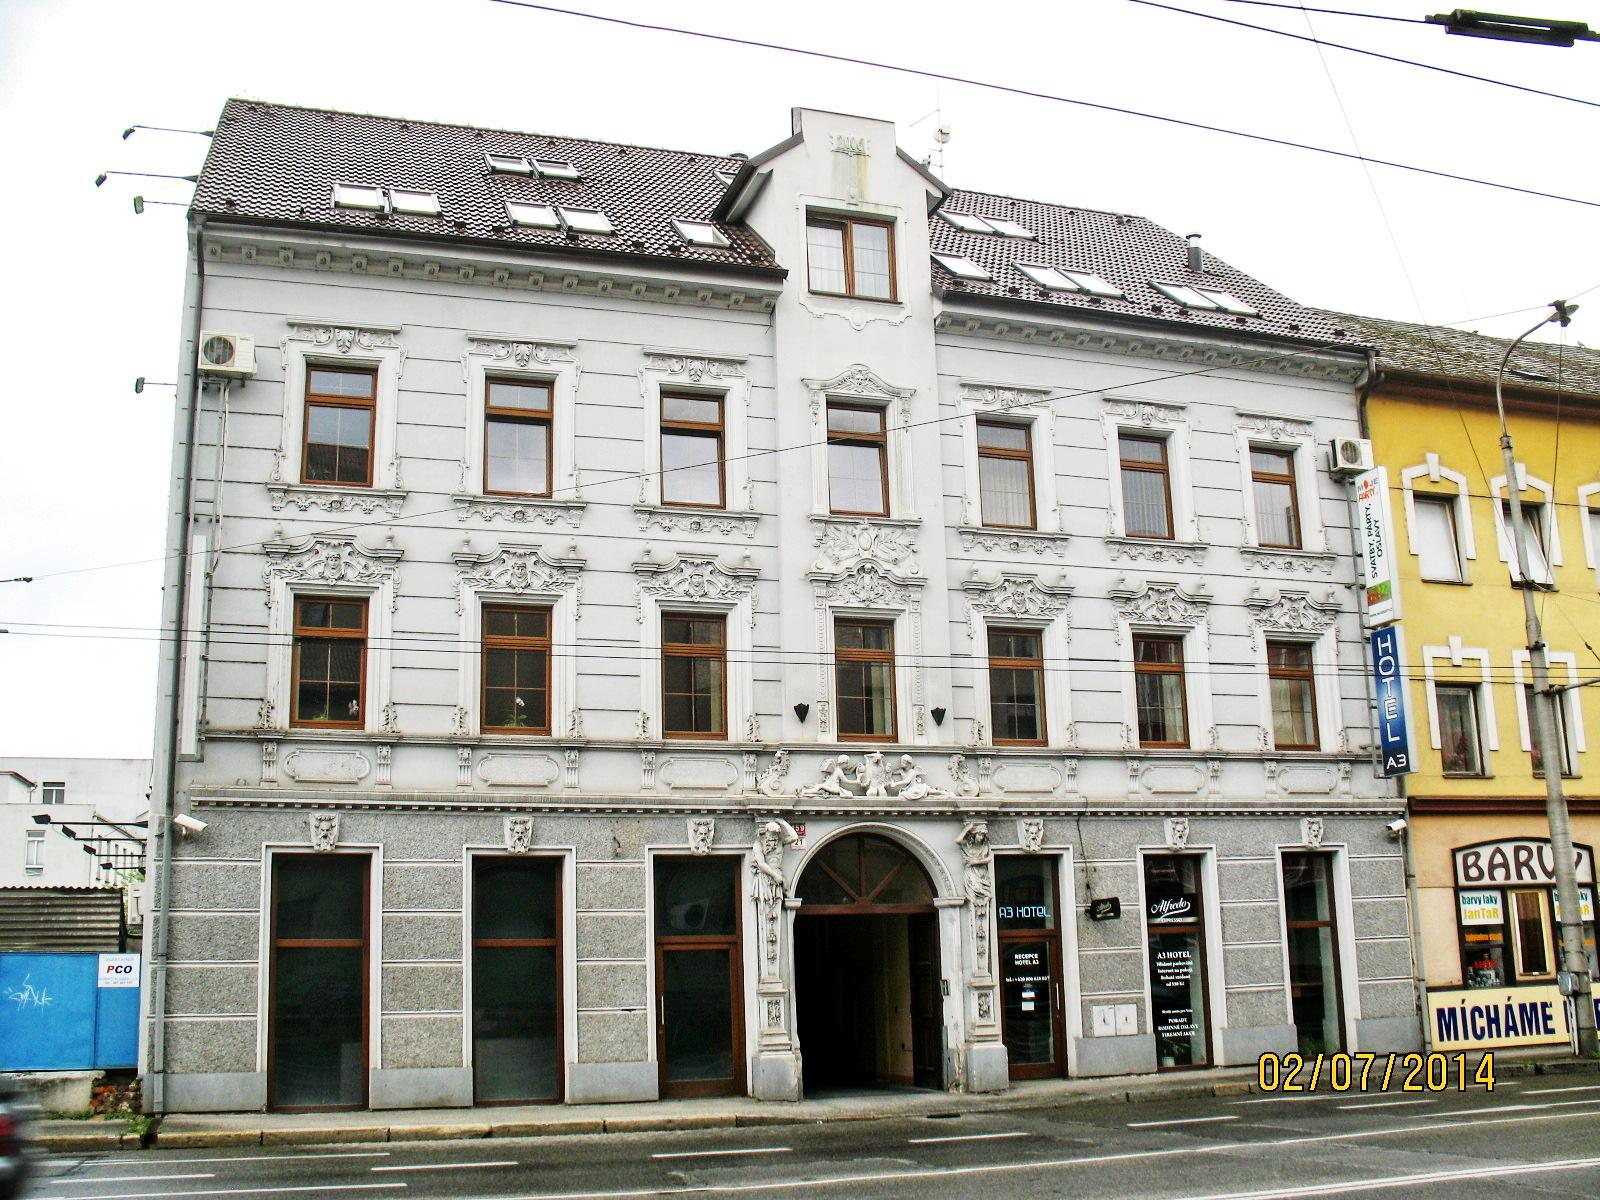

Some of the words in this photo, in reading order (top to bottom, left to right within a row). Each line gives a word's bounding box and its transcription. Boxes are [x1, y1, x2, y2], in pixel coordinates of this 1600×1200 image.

[1373, 519, 1383, 557] OSLAVY
[1377, 634, 1401, 743] HOTEL
[1386, 754, 1407, 770] A3
[1462, 845, 1582, 882] BARV
[1151, 898, 1191, 914] Alfredo
[1461, 895, 1481, 905] barvy
[1482, 894, 1498, 904] laky
[999, 906, 1014, 918] A3
[1167, 950, 1192, 959] HOTEL
[106, 965, 133, 974] PCO
[1436, 996, 1556, 1042] MÍCHÁME
